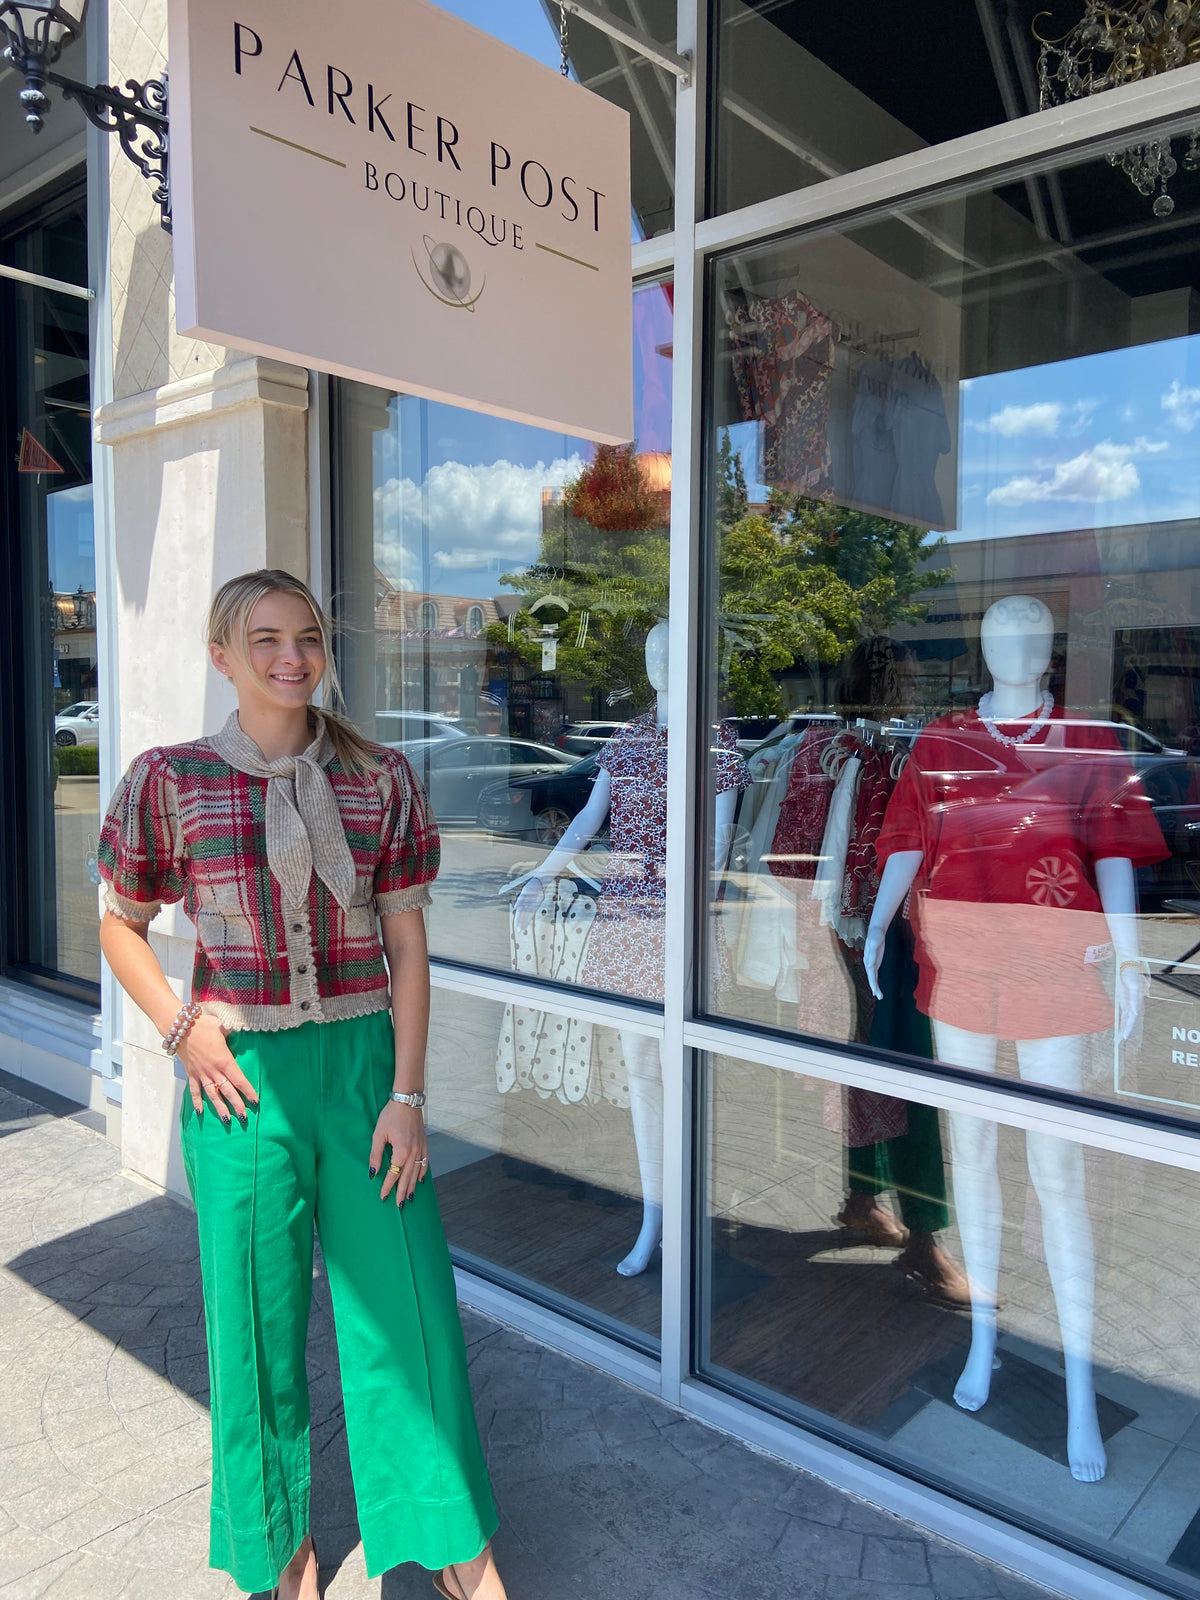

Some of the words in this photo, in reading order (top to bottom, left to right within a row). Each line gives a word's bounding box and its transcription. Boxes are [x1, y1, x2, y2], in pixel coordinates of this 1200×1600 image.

[233, 21, 462, 171] PARKER
[491, 141, 606, 232] POST
[364, 161, 524, 250] BOUTIQUE
[1171, 1050, 1200, 1068] RE
